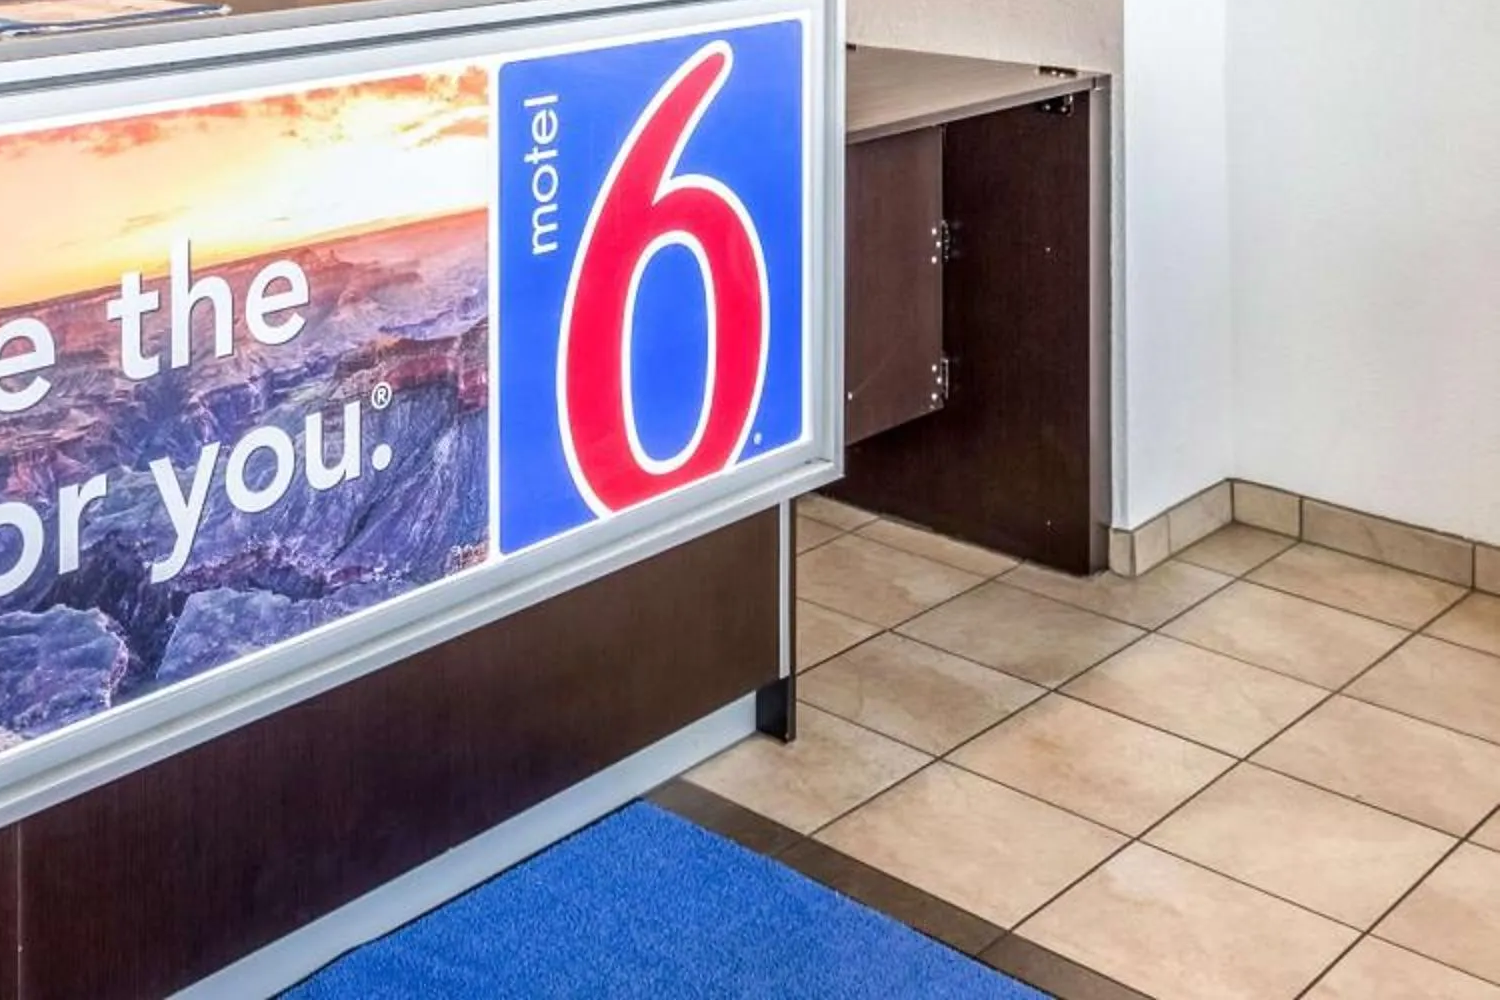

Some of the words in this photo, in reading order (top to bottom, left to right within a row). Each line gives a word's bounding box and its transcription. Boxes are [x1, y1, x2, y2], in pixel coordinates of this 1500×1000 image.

[523, 93, 559, 257] motel
[106, 237, 311, 382] the
[556, 39, 771, 517] 6
